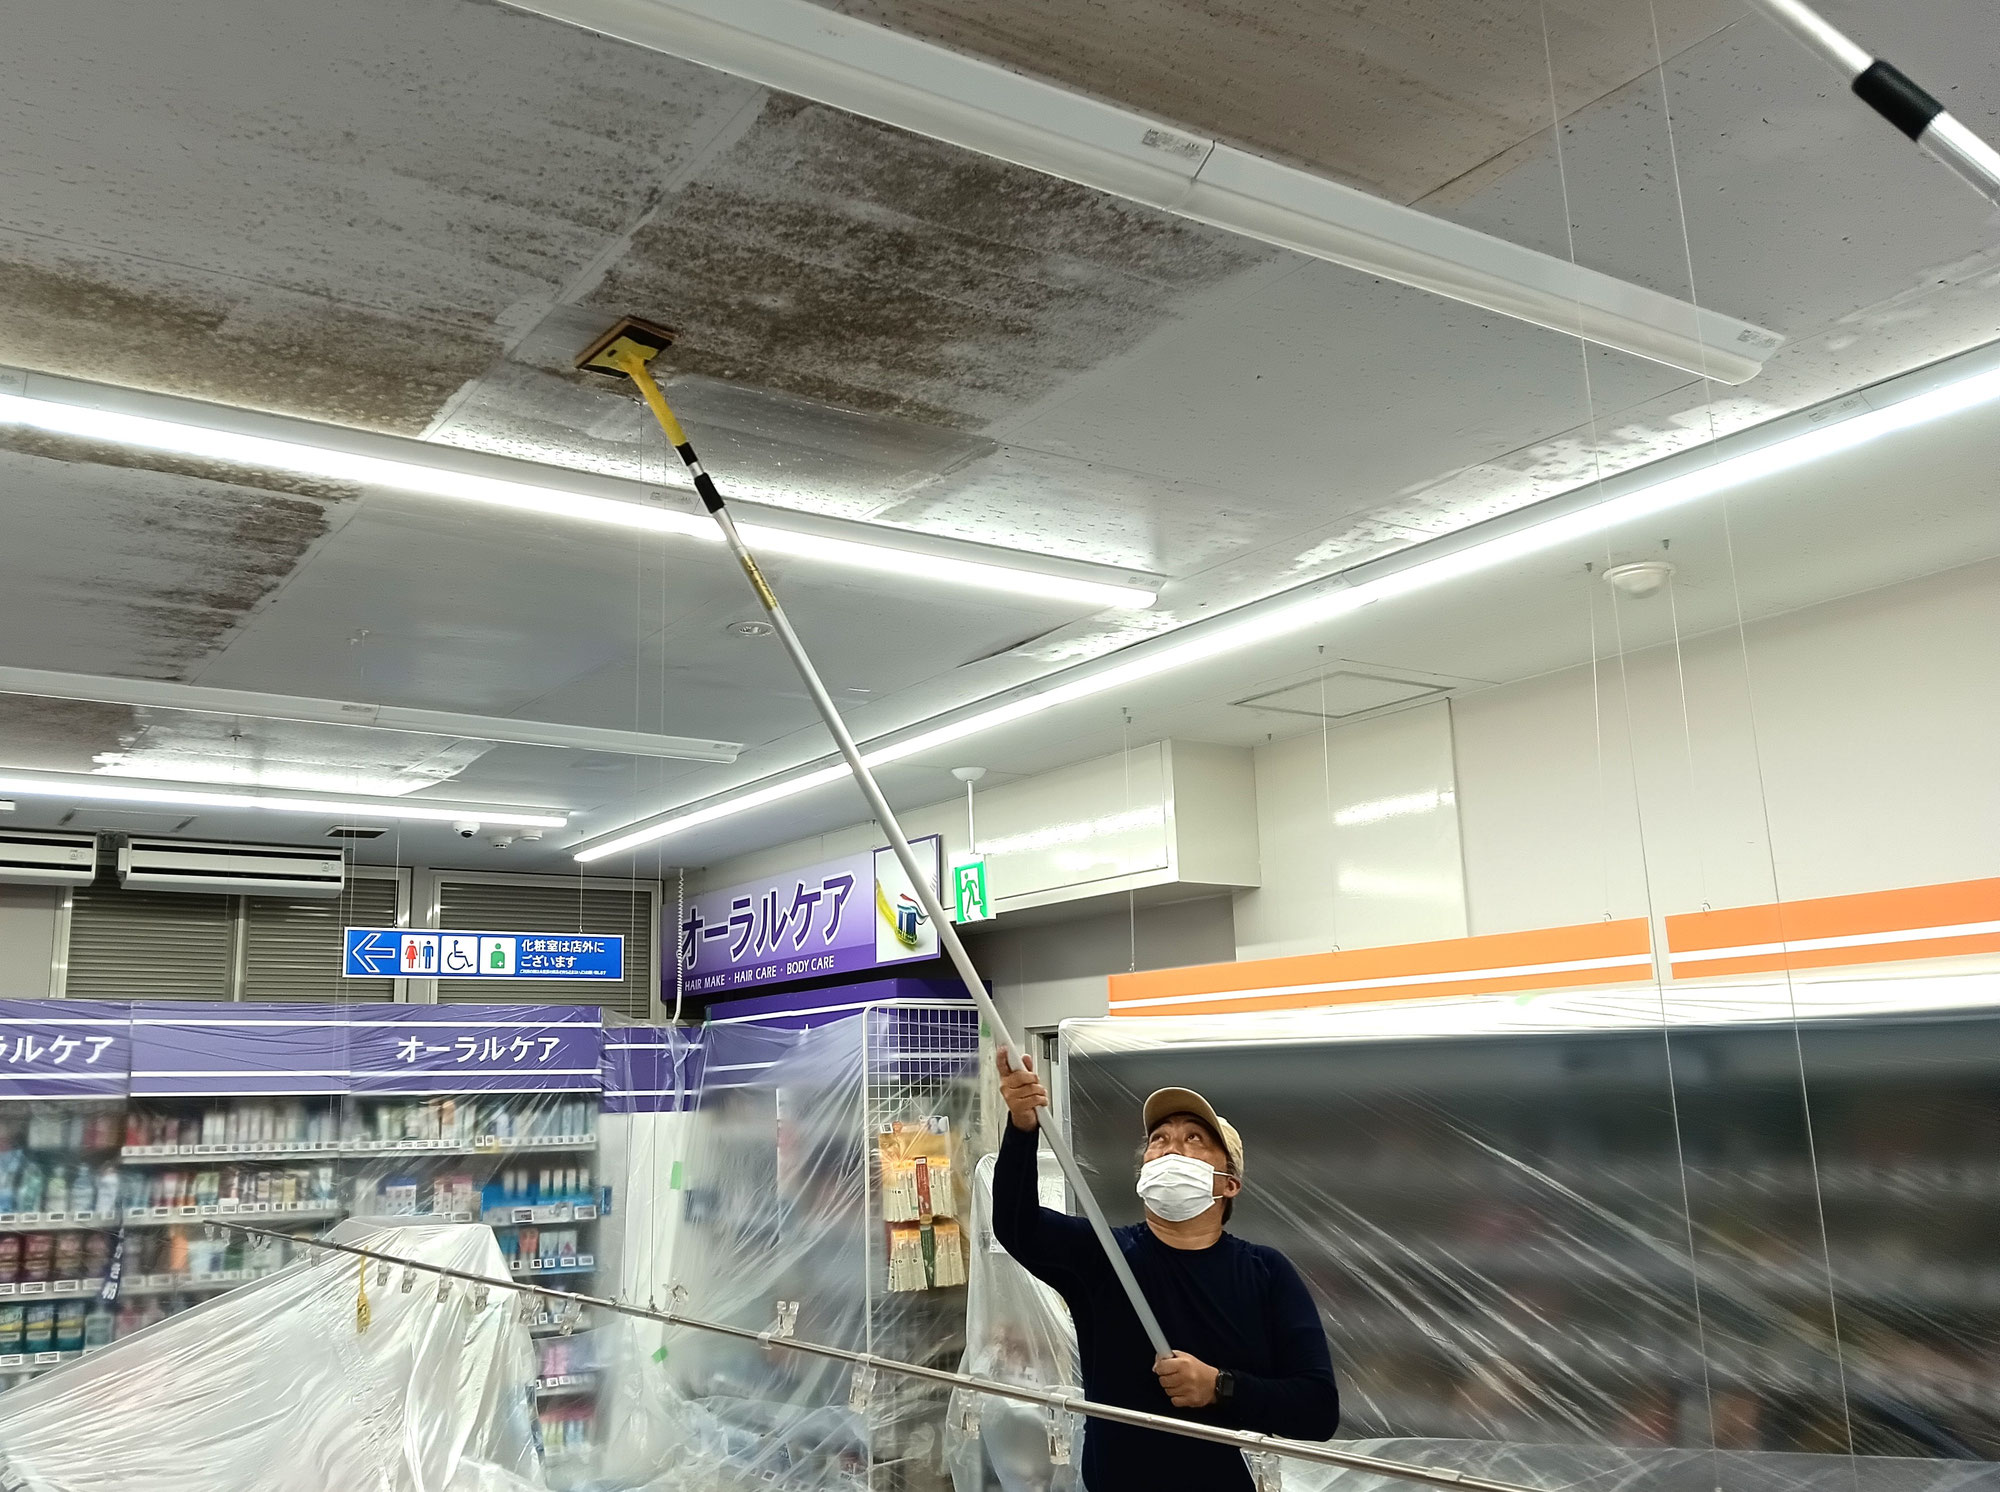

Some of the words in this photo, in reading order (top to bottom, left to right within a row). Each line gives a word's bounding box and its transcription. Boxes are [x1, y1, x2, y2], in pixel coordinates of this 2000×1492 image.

[681, 872, 856, 969] オーラルケア
[521, 939, 605, 953] 化粧室は店外に
[521, 954, 577, 968] ございます
[684, 979, 702, 992] HAIR
[703, 974, 726, 988] MAKE
[733, 968, 753, 984] HAIR
[755, 965, 777, 980] CARE
[786, 959, 810, 975] BODY
[811, 955, 835, 971] CARE
[0, 1034, 114, 1064] ルケア
[396, 1035, 560, 1063] オーラルケア
